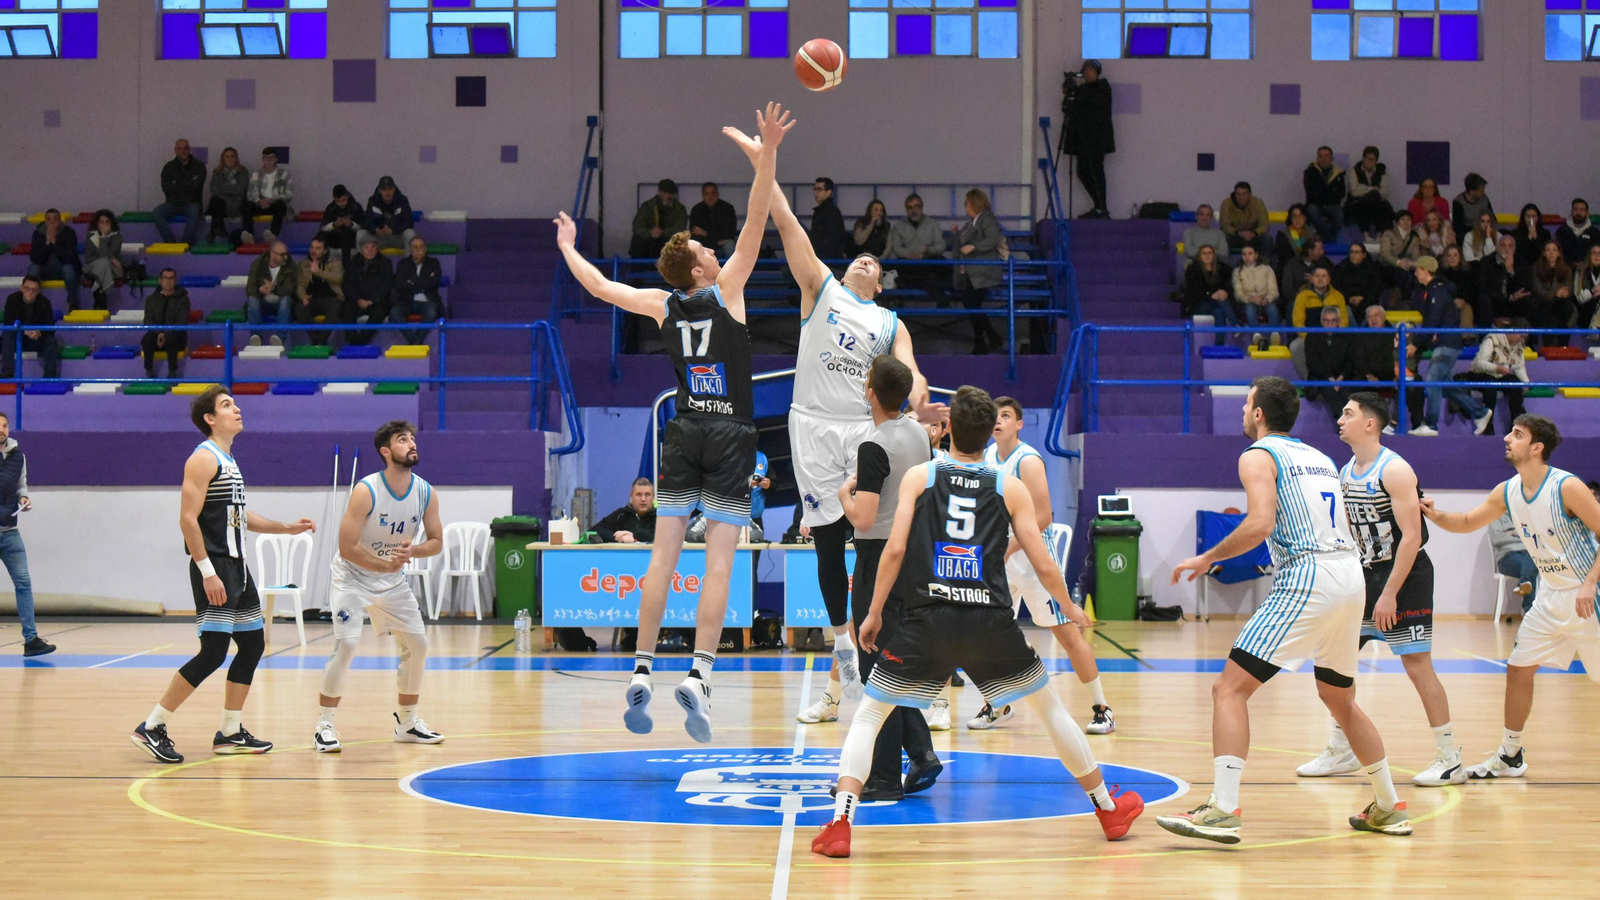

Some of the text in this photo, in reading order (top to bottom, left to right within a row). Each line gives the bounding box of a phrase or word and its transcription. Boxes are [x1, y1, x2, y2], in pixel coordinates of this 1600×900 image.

[675, 318, 713, 357] 17
[838, 332, 856, 351] 12
[826, 362, 863, 378] OCHOA
[833, 354, 864, 369] Hospital
[705, 399, 733, 415] STROG
[950, 475, 980, 489] TAVIO
[945, 494, 977, 541] 5
[1320, 491, 1336, 529] 7
[390, 521, 405, 535] 14
[937, 557, 979, 579] UBAGO
[579, 567, 706, 600] depte
[951, 587, 990, 604] STROG
[1409, 625, 1425, 641] 12
